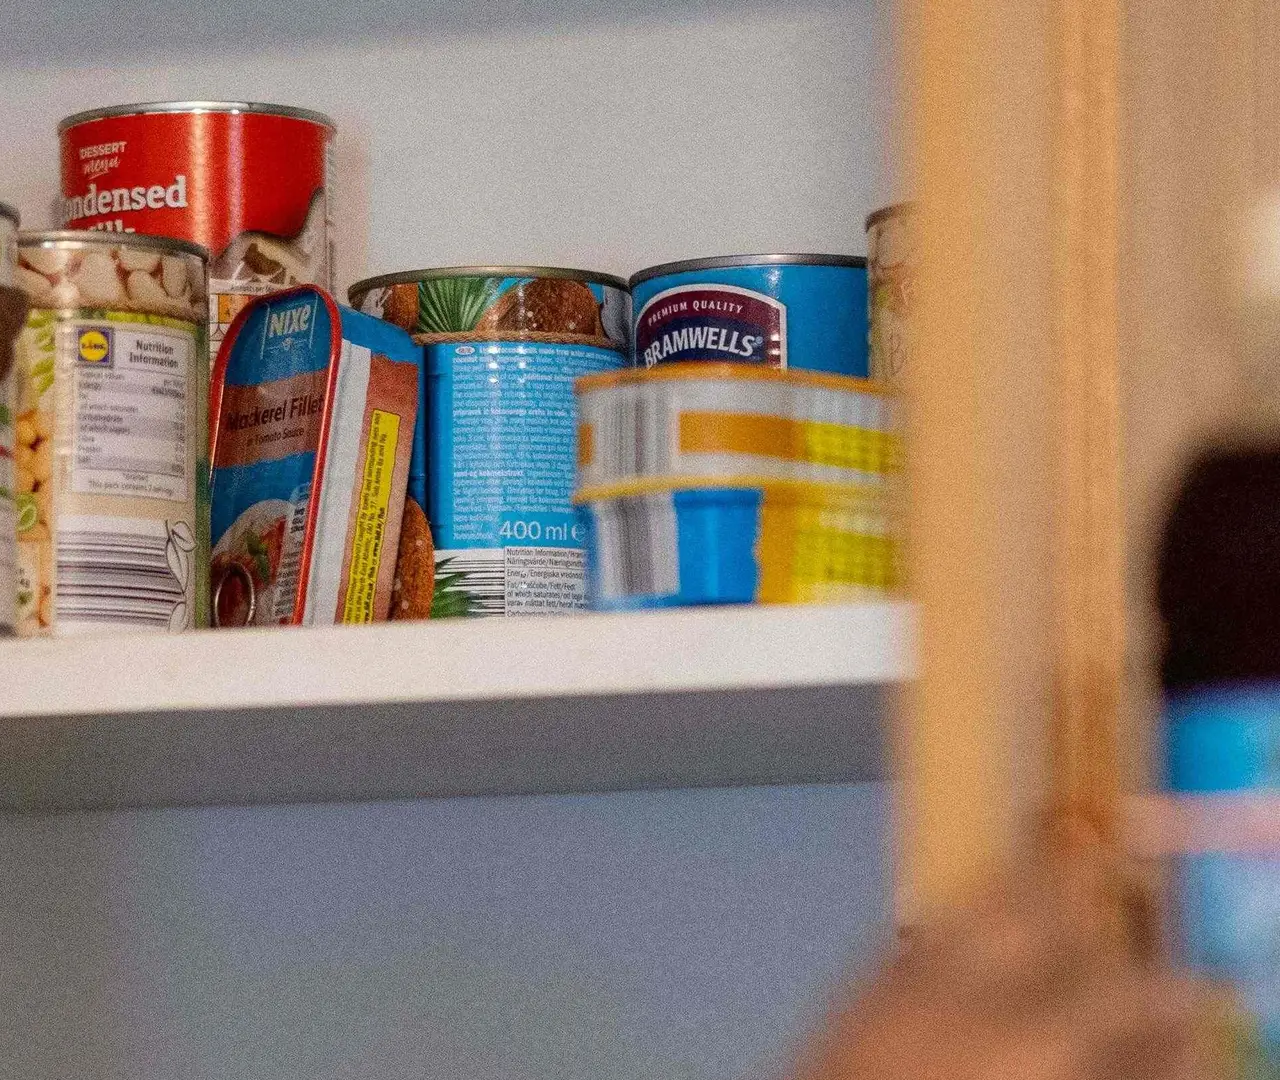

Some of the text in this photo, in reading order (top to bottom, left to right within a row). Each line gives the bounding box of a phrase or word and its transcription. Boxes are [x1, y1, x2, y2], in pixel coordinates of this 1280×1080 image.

[80, 141, 128, 160] DESSERT
[647, 299, 745, 327] PREMIUM QUALITY
[136, 340, 174, 355] Nutrition
[643, 326, 756, 369] BRAMWELLS
[130, 352, 179, 368] Information
[499, 520, 542, 540] 400
[545, 522, 568, 541] ml
